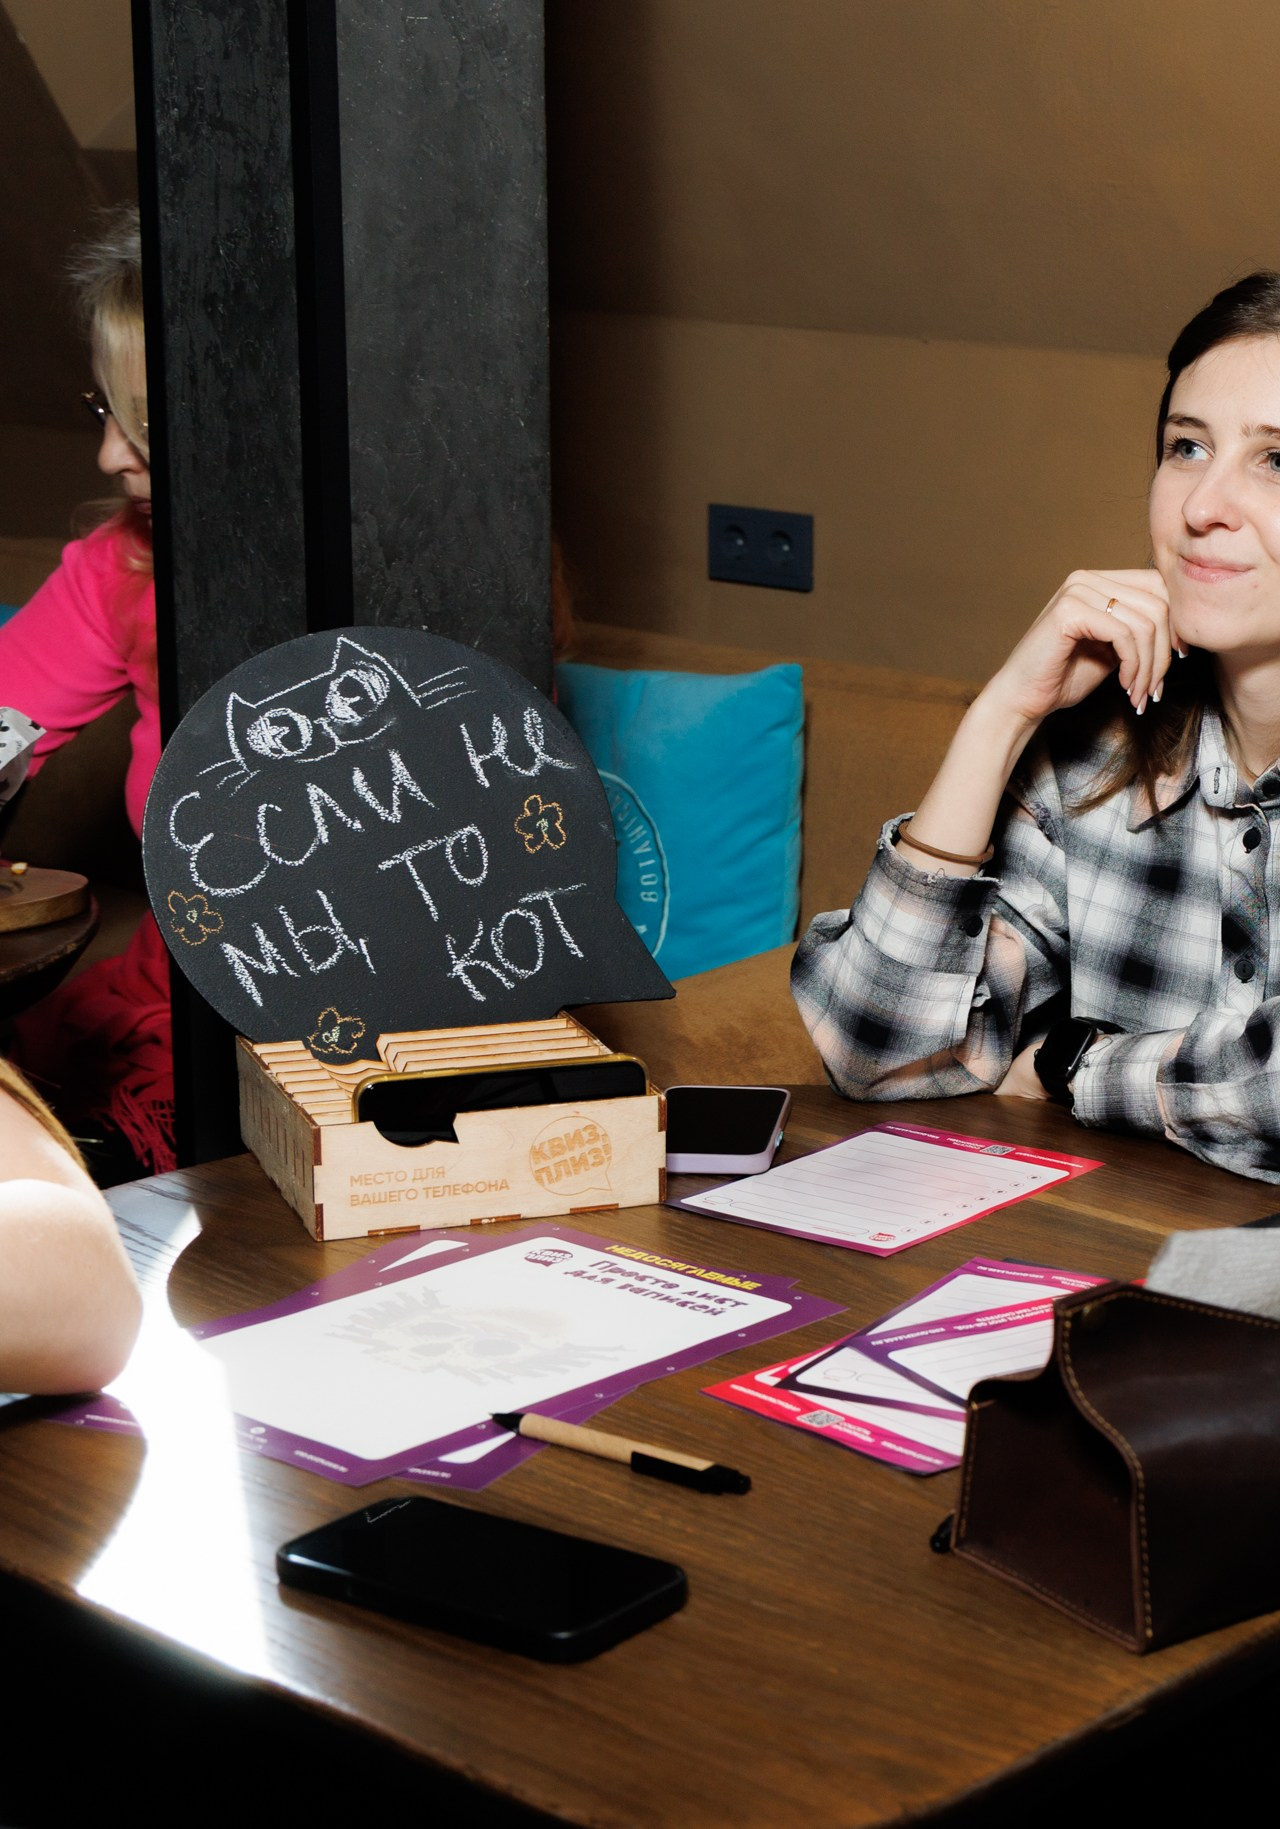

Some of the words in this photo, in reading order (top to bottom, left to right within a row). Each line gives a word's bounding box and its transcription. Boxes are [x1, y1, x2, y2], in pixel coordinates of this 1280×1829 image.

[377, 824, 490, 922] ТО
[445, 882, 587, 1002] КОТ
[350, 1169, 407, 1187] МЕСТО
[412, 1166, 446, 1183] ДЛЯ
[534, 1143, 612, 1188] ПЛИЗ!
[350, 1187, 417, 1206] ВАШЕГО
[422, 1178, 511, 1200] ТЕЛЕФОНА
[604, 1244, 763, 1291] НЕДОСЯГАЕМЫЕ
